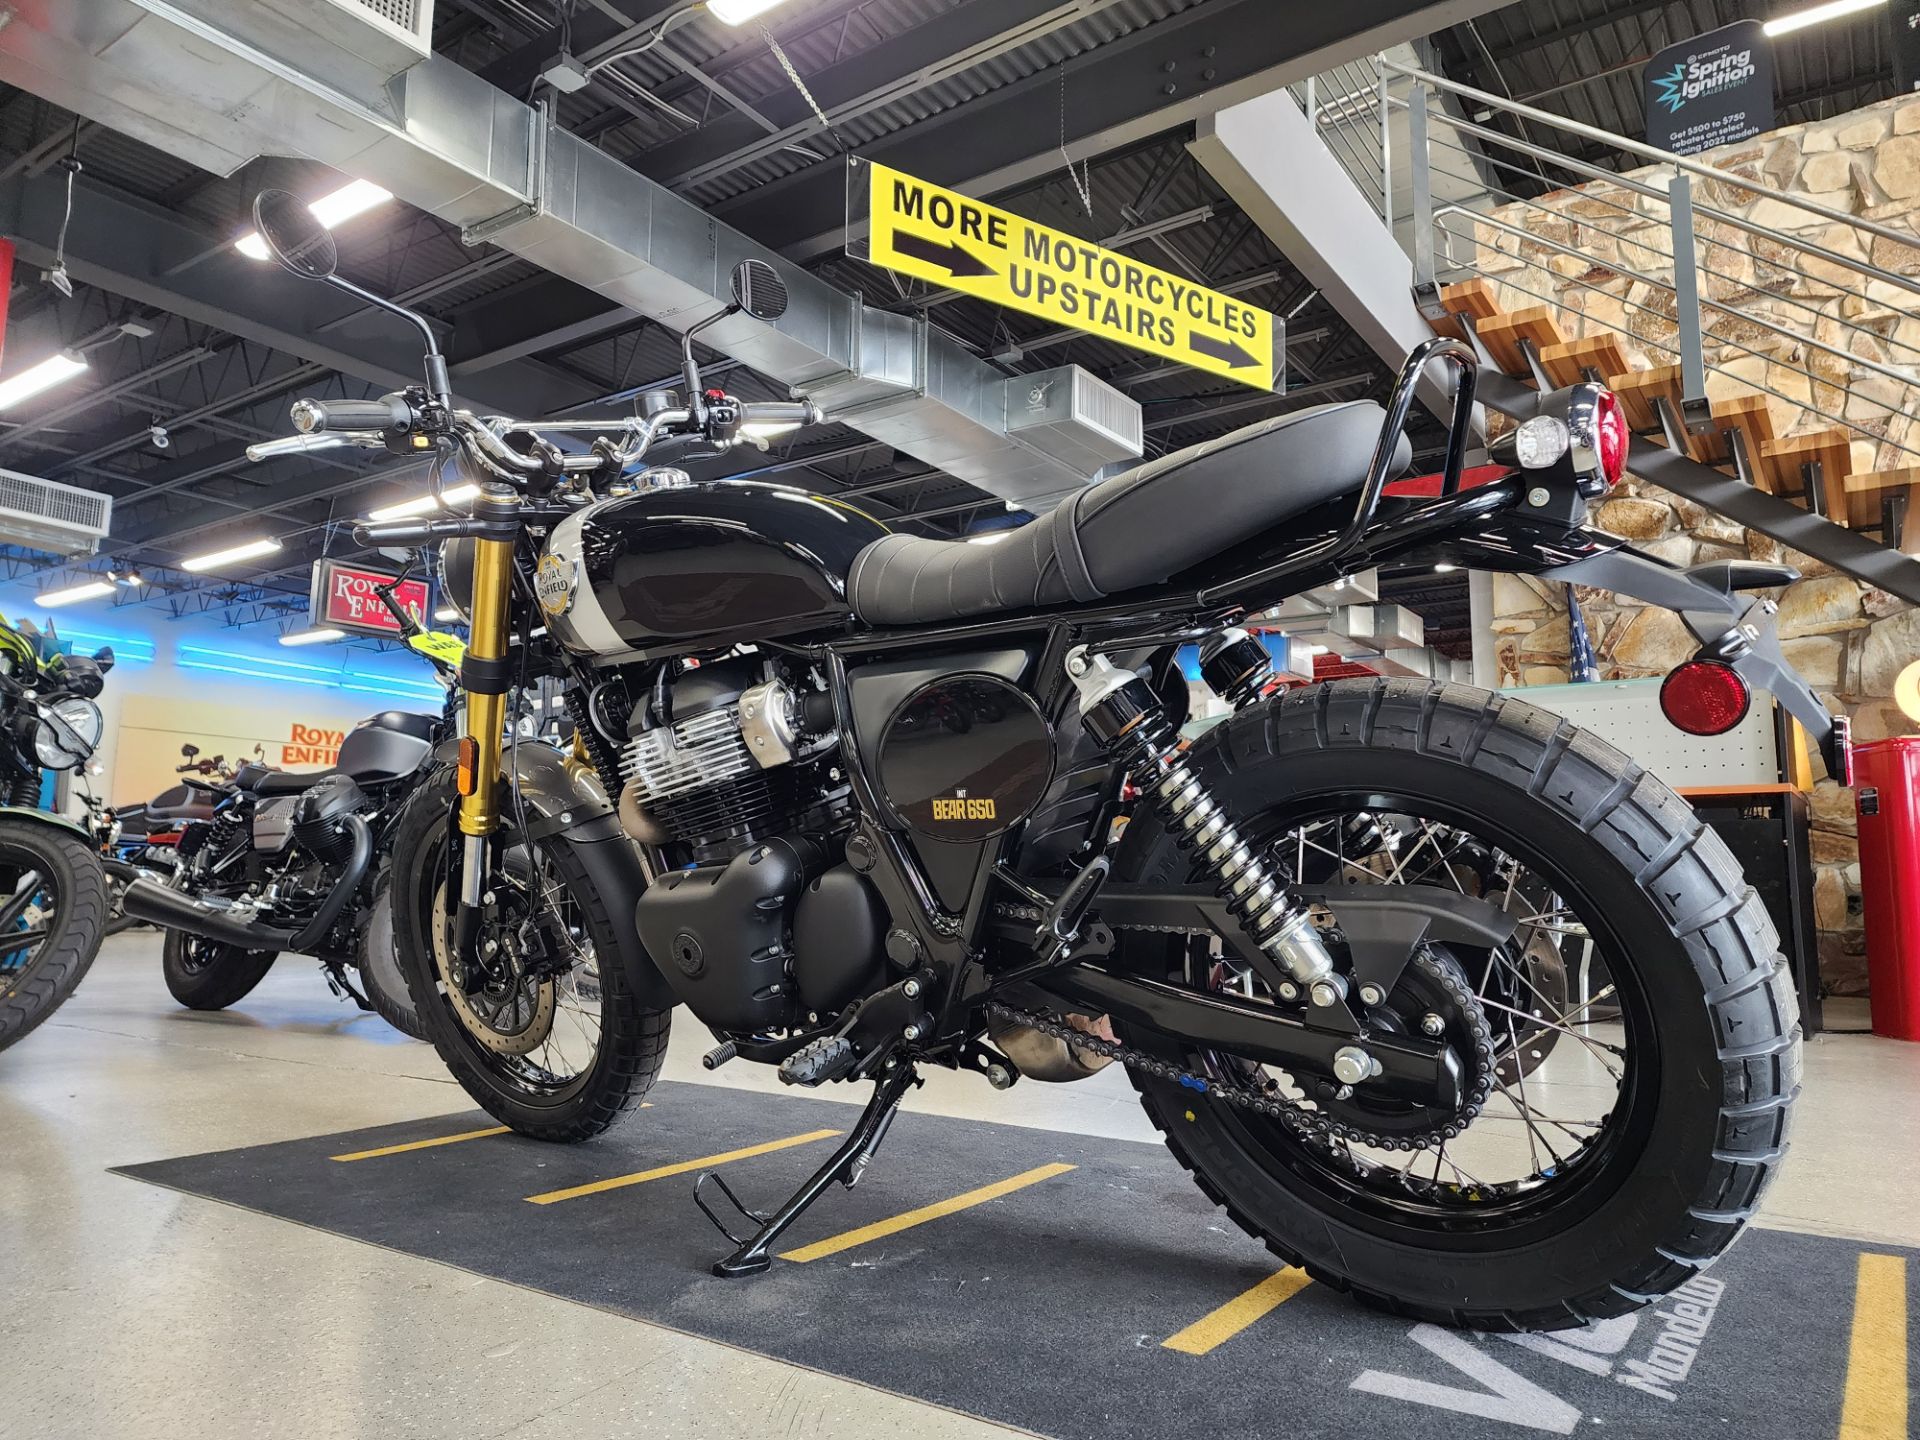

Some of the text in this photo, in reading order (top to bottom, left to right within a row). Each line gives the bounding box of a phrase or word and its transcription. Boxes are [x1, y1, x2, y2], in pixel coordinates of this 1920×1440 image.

[1688, 50, 1750, 80] Spring
[1697, 45, 1730, 59] CFMOTO
[1682, 64, 1755, 99] Ignition
[1701, 77, 1748, 97] SALES EVENT
[1669, 112, 1746, 141] Get $500 to $750
[1671, 121, 1744, 149] rebates on select
[1703, 135, 1726, 149] 2022
[1727, 126, 1760, 141] models
[892, 178, 1258, 340] MORE MOTORCYCLES
[1009, 263, 1176, 347] UPSTAIRS
[334, 574, 400, 603] ROYL
[291, 722, 345, 746] ROYA
[281, 744, 338, 765] ENFI
[956, 789, 967, 799] INT
[932, 798, 996, 820] BEAR 650
[1614, 1274, 1727, 1402] Mandello
